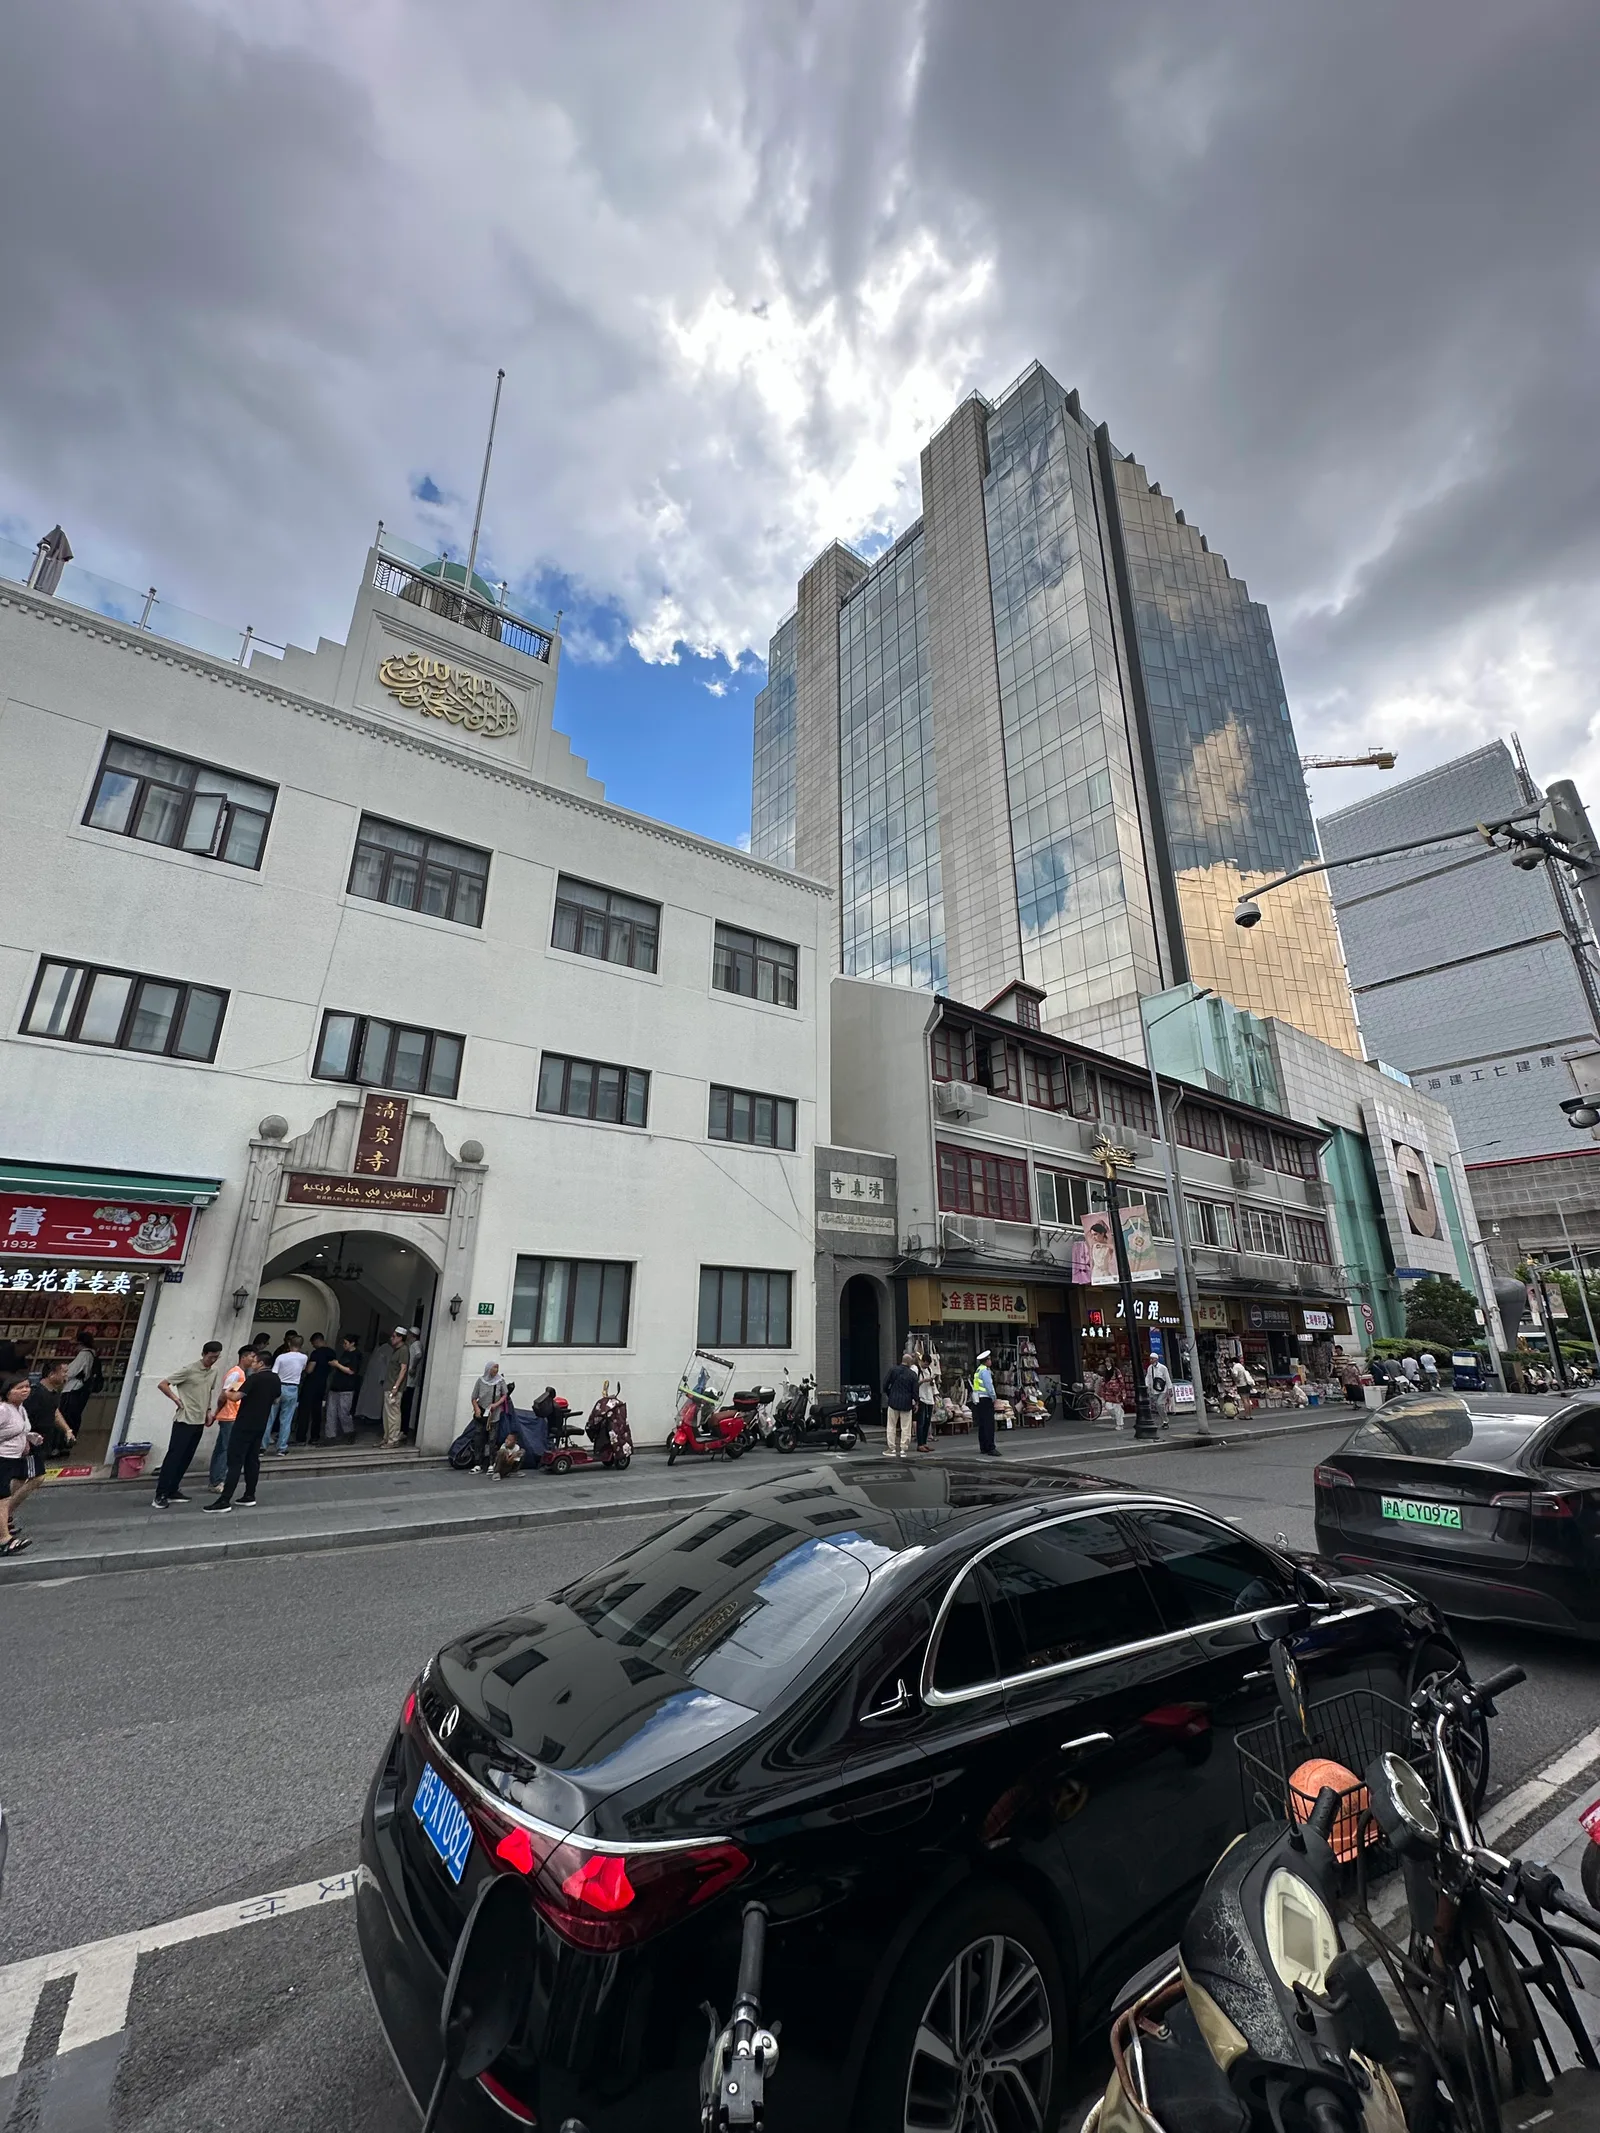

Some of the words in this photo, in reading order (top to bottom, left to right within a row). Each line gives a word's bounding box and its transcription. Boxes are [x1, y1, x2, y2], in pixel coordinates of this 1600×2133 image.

[1414, 1050, 1579, 1092] 海建工七建集
[363, 1101, 399, 1172] 清真寺
[831, 1177, 884, 1200] 清真寺
[8, 1205, 48, 1237] 膏
[1, 1239, 38, 1249] 1932
[949, 1291, 1014, 1312] 金鑫百货店
[1366, 1321, 1373, 1331] 5
[1406, 1503, 1460, 1526] CY0972
